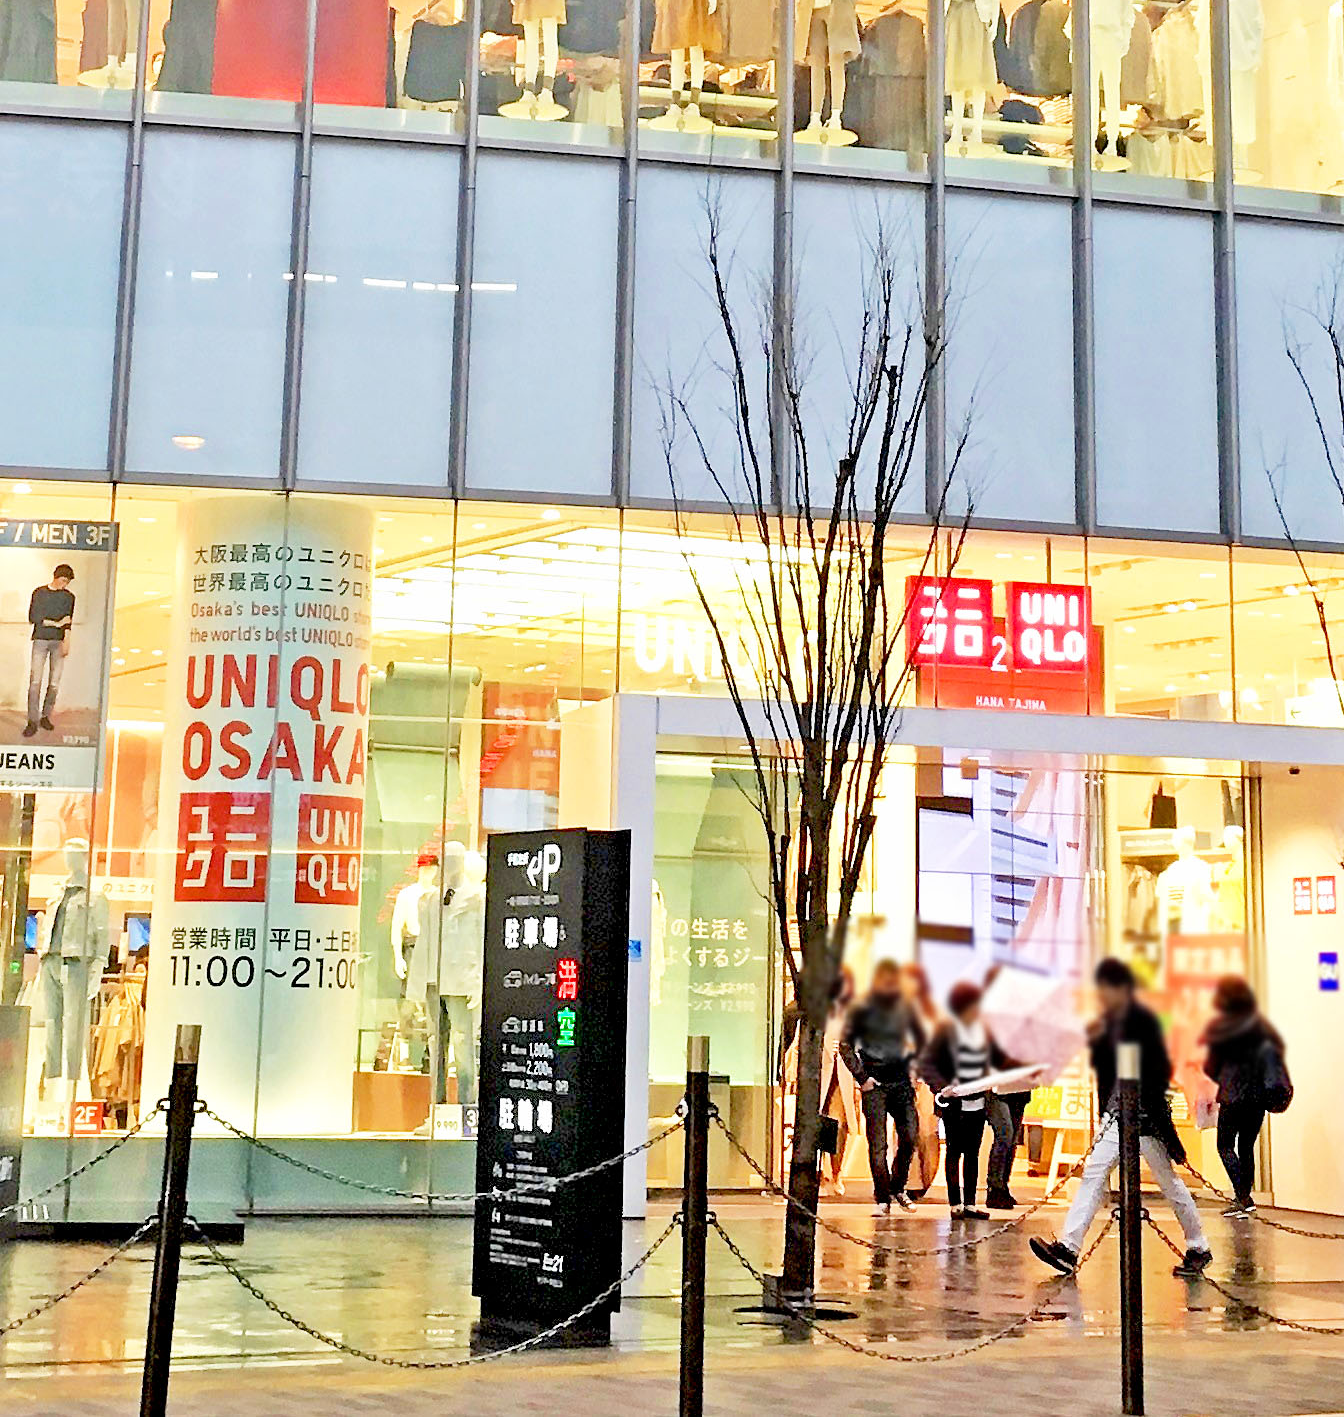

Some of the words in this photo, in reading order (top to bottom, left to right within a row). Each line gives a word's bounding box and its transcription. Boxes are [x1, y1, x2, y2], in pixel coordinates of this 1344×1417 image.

[32, 525, 78, 545] MEN
[86, 526, 111, 546] 3F
[191, 601, 244, 618] Osaka's
[295, 601, 349, 622] UNIQLO
[1020, 592, 1080, 627] UNI
[190, 627, 207, 643] the
[211, 626, 261, 642] world's
[302, 628, 352, 647] UNIQLO
[1020, 628, 1086, 665] QLO
[186, 655, 369, 721] UNIQLO
[975, 695, 1005, 708] HANA
[182, 721, 366, 784] OSAKA
[171, 927, 257, 951] 営業時間
[75, 1106, 98, 1123] 2F
